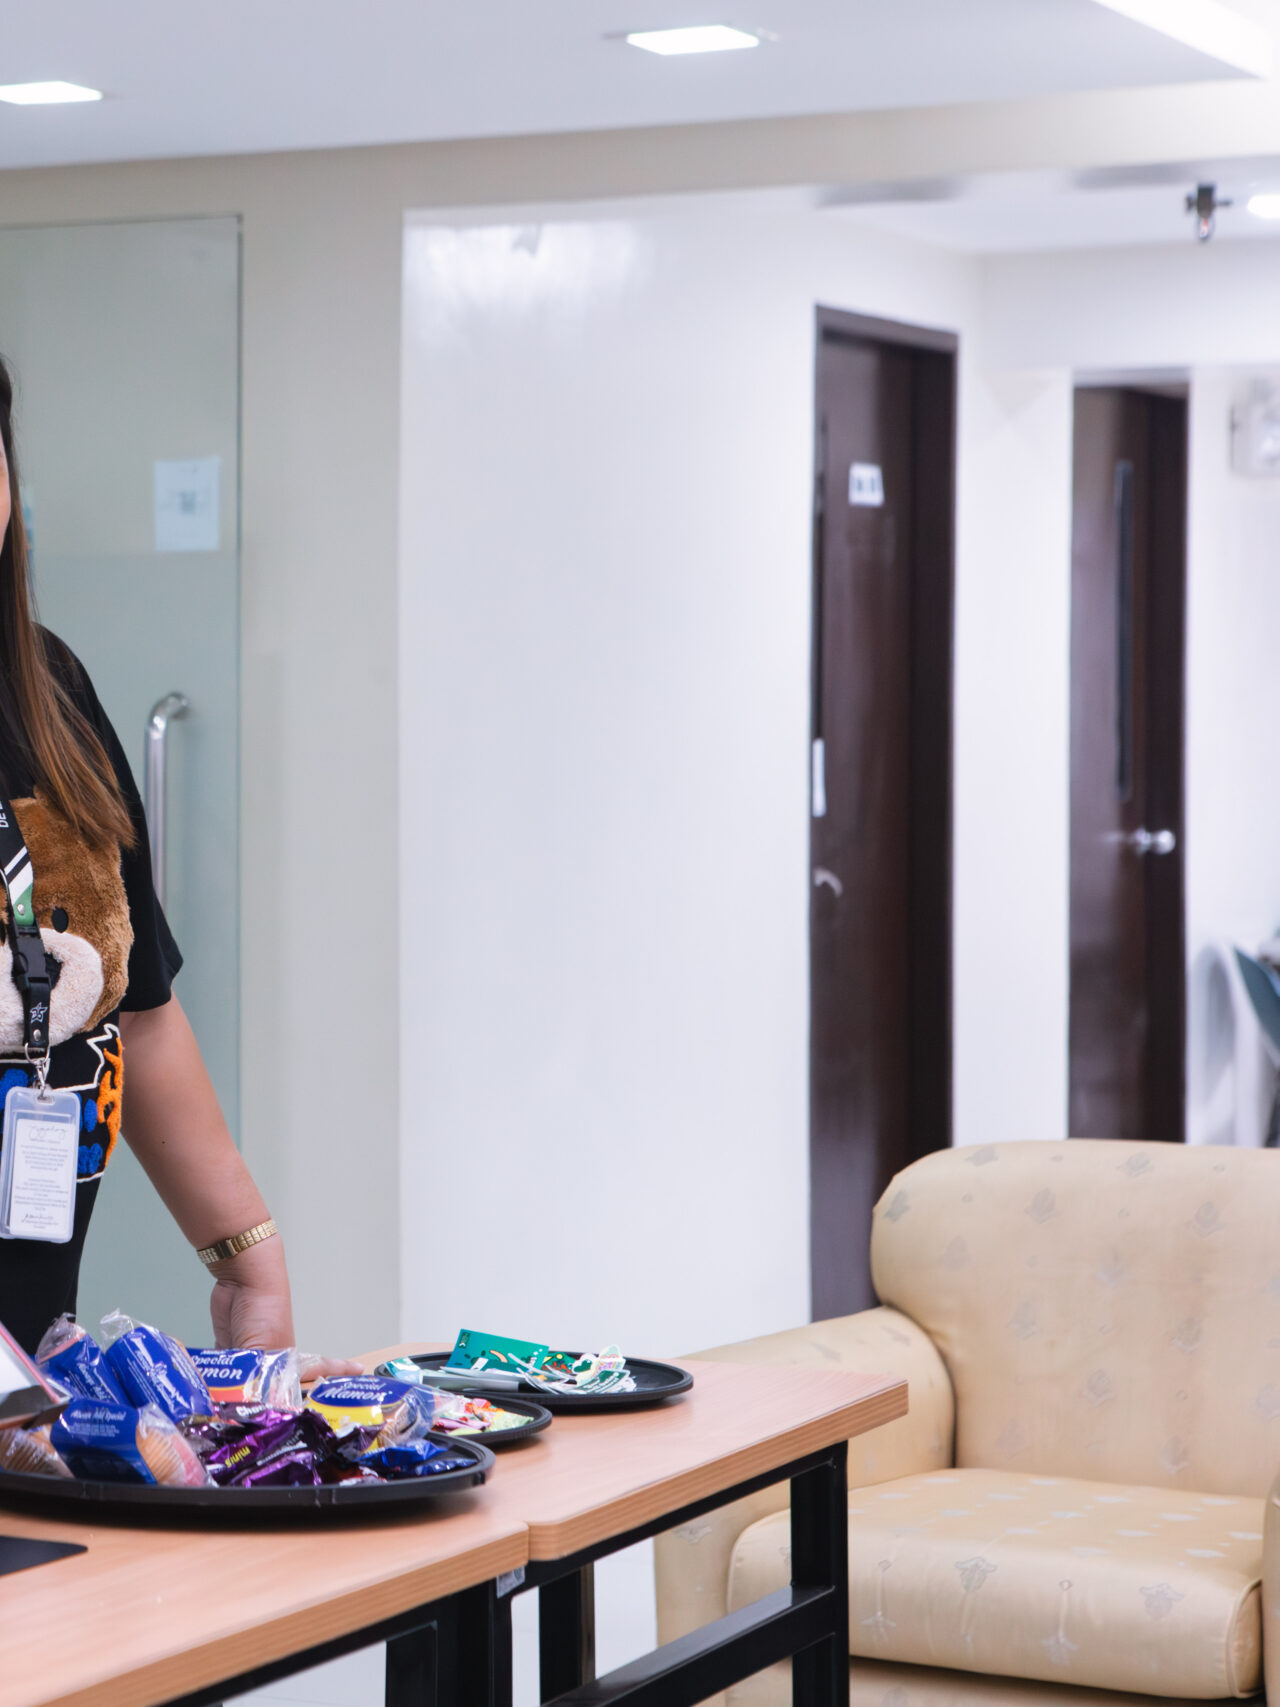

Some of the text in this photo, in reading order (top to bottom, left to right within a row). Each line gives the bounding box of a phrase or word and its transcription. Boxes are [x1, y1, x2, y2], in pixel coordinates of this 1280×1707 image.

[198, 1367, 243, 1380] mon
[341, 1381, 386, 1391] Special
[317, 1386, 387, 1401] Mamon
